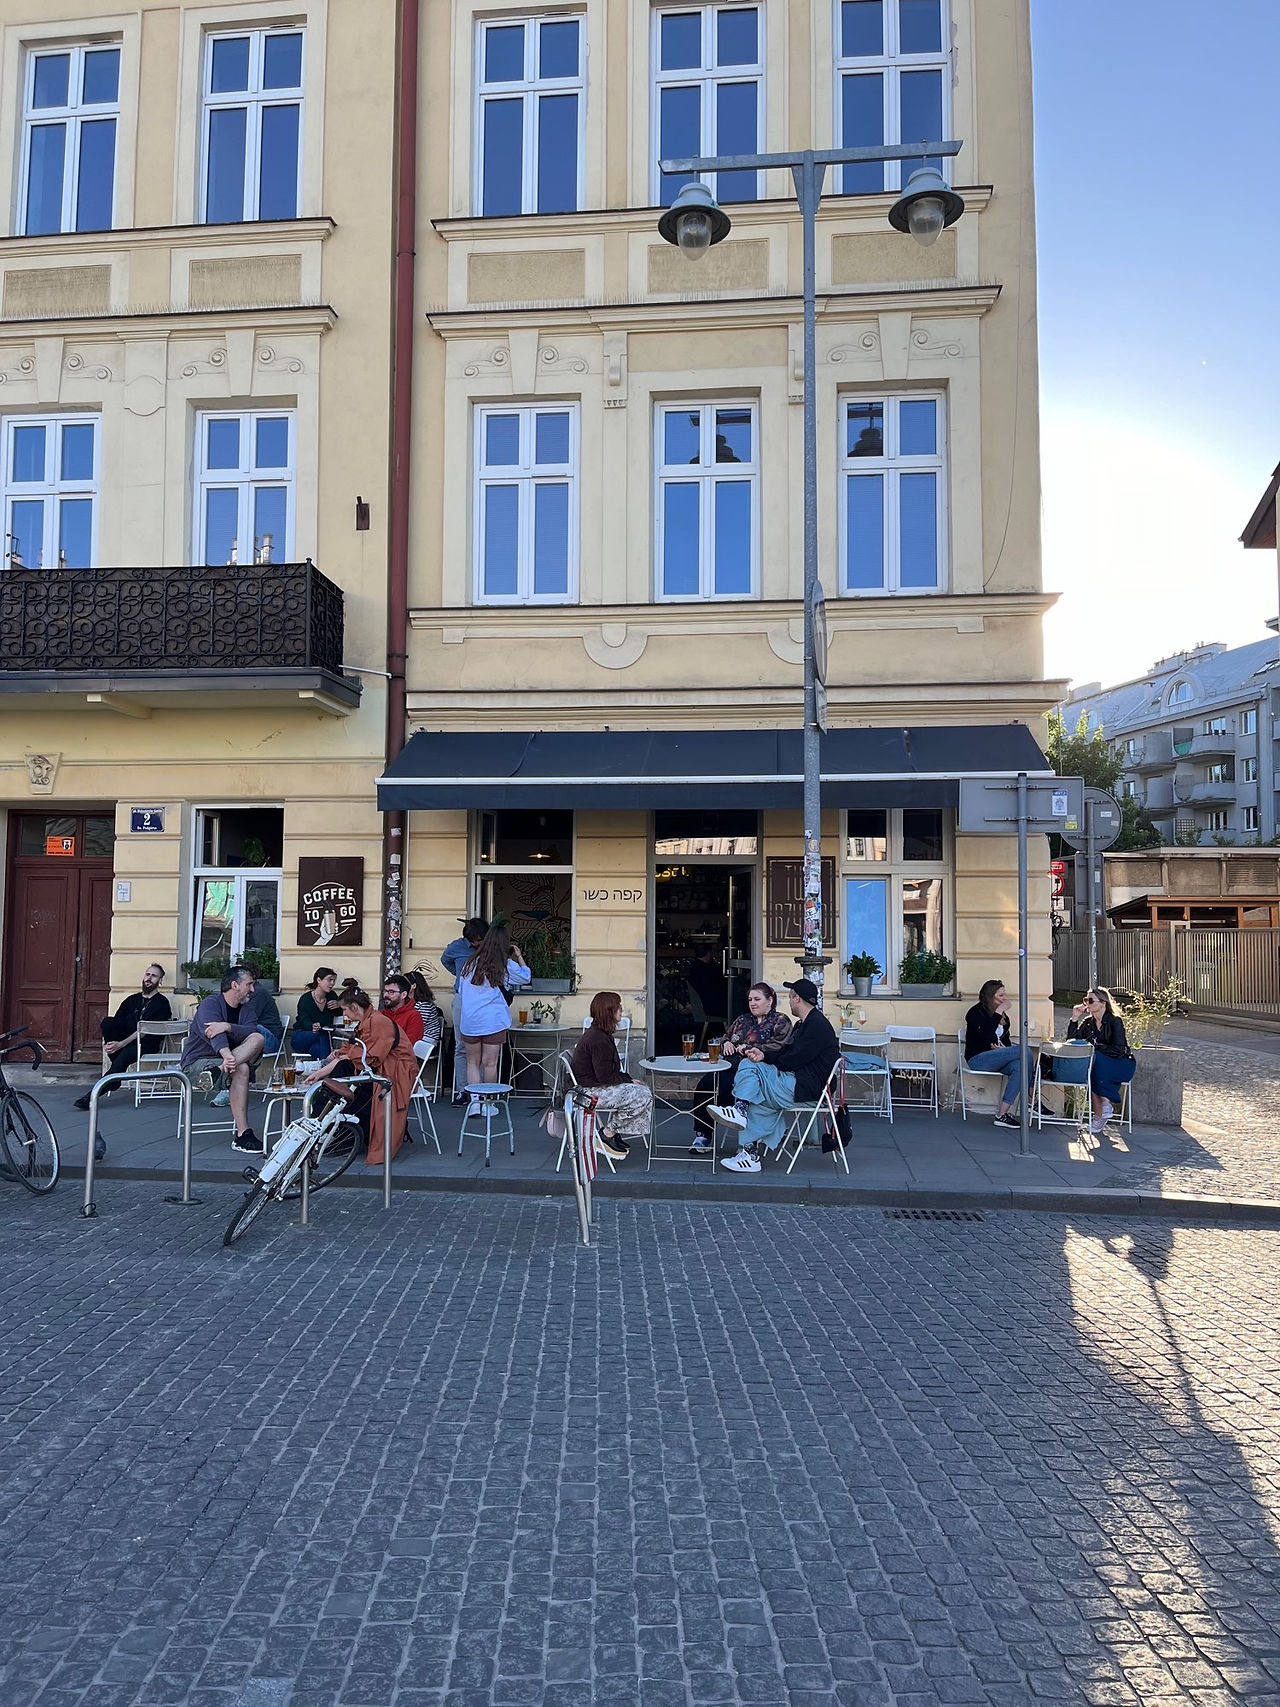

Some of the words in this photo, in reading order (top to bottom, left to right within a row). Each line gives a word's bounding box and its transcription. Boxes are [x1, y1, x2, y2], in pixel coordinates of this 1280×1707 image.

[143, 812, 151, 826] 2
[303, 888, 355, 905] COFFEE
[613, 889, 642, 903] קפה
[304, 910, 320, 921] TO
[340, 905, 356, 917] GO
